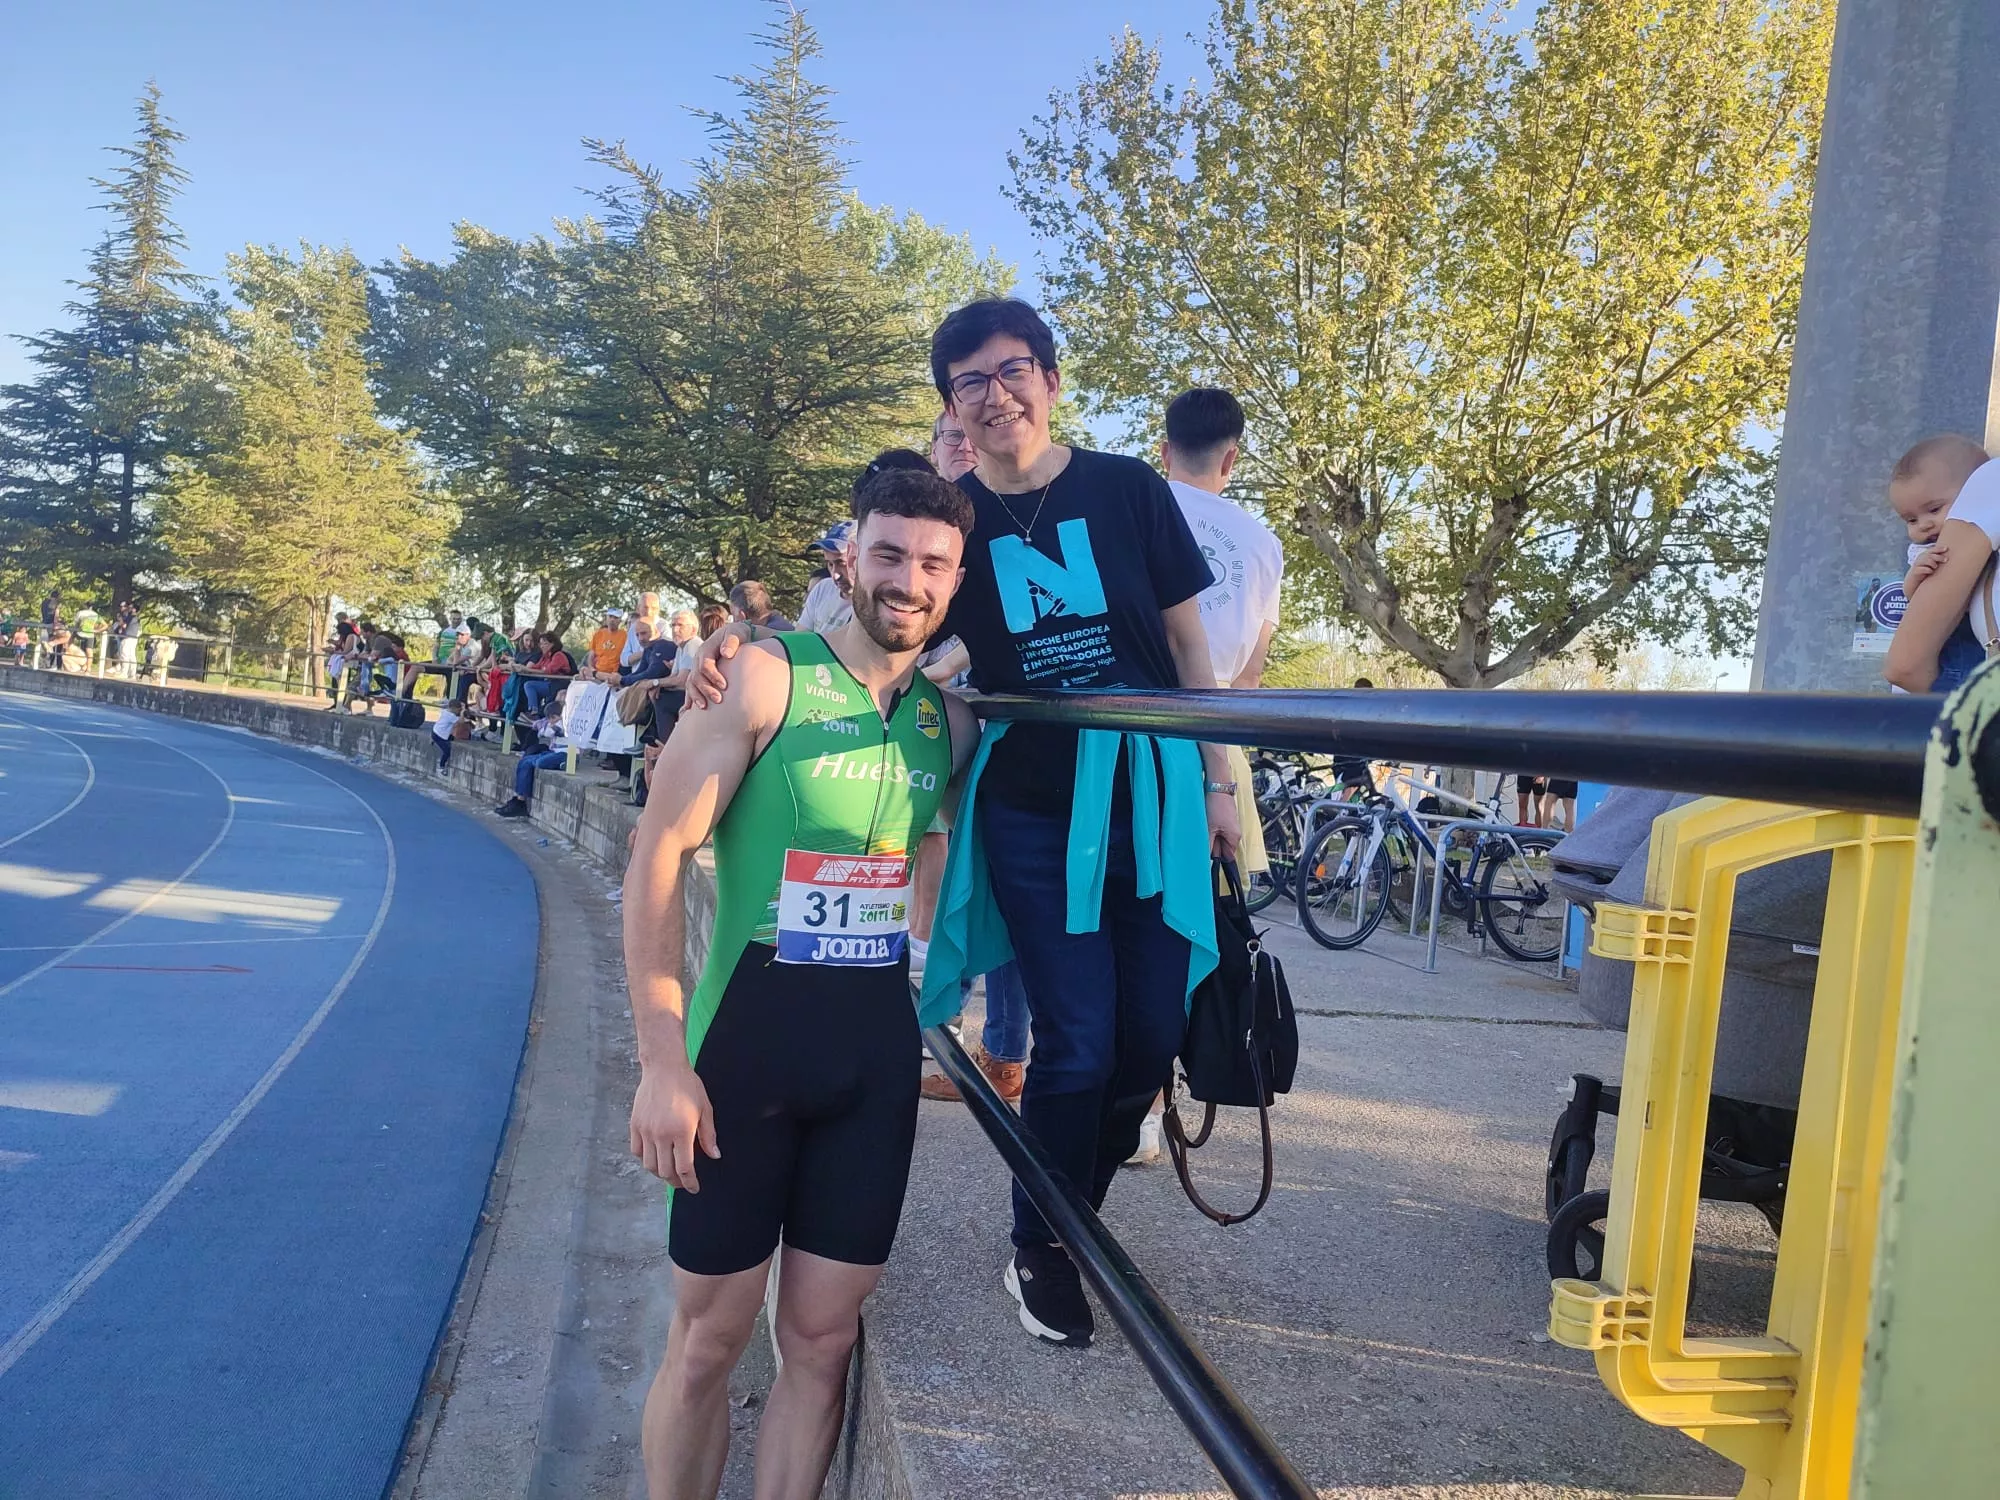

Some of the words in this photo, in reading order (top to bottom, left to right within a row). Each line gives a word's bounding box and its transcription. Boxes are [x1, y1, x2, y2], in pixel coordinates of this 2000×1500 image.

[1197, 518, 1207, 529] IN
[1208, 525, 1238, 553] MOTION
[1231, 560, 1243, 570] GO
[1230, 573, 1242, 589] OUT
[1028, 634, 1061, 649] NOCHE
[1063, 624, 1111, 641] EUROPEA
[1023, 663, 1030, 672] E
[1097, 656, 1117, 667] Night
[805, 683, 848, 704] VIATOR
[822, 718, 860, 737] ZOITI
[811, 751, 937, 792] Huesca
[853, 862, 904, 878] RFEA
[803, 891, 851, 928] 31
[859, 910, 888, 922] ZOITI
